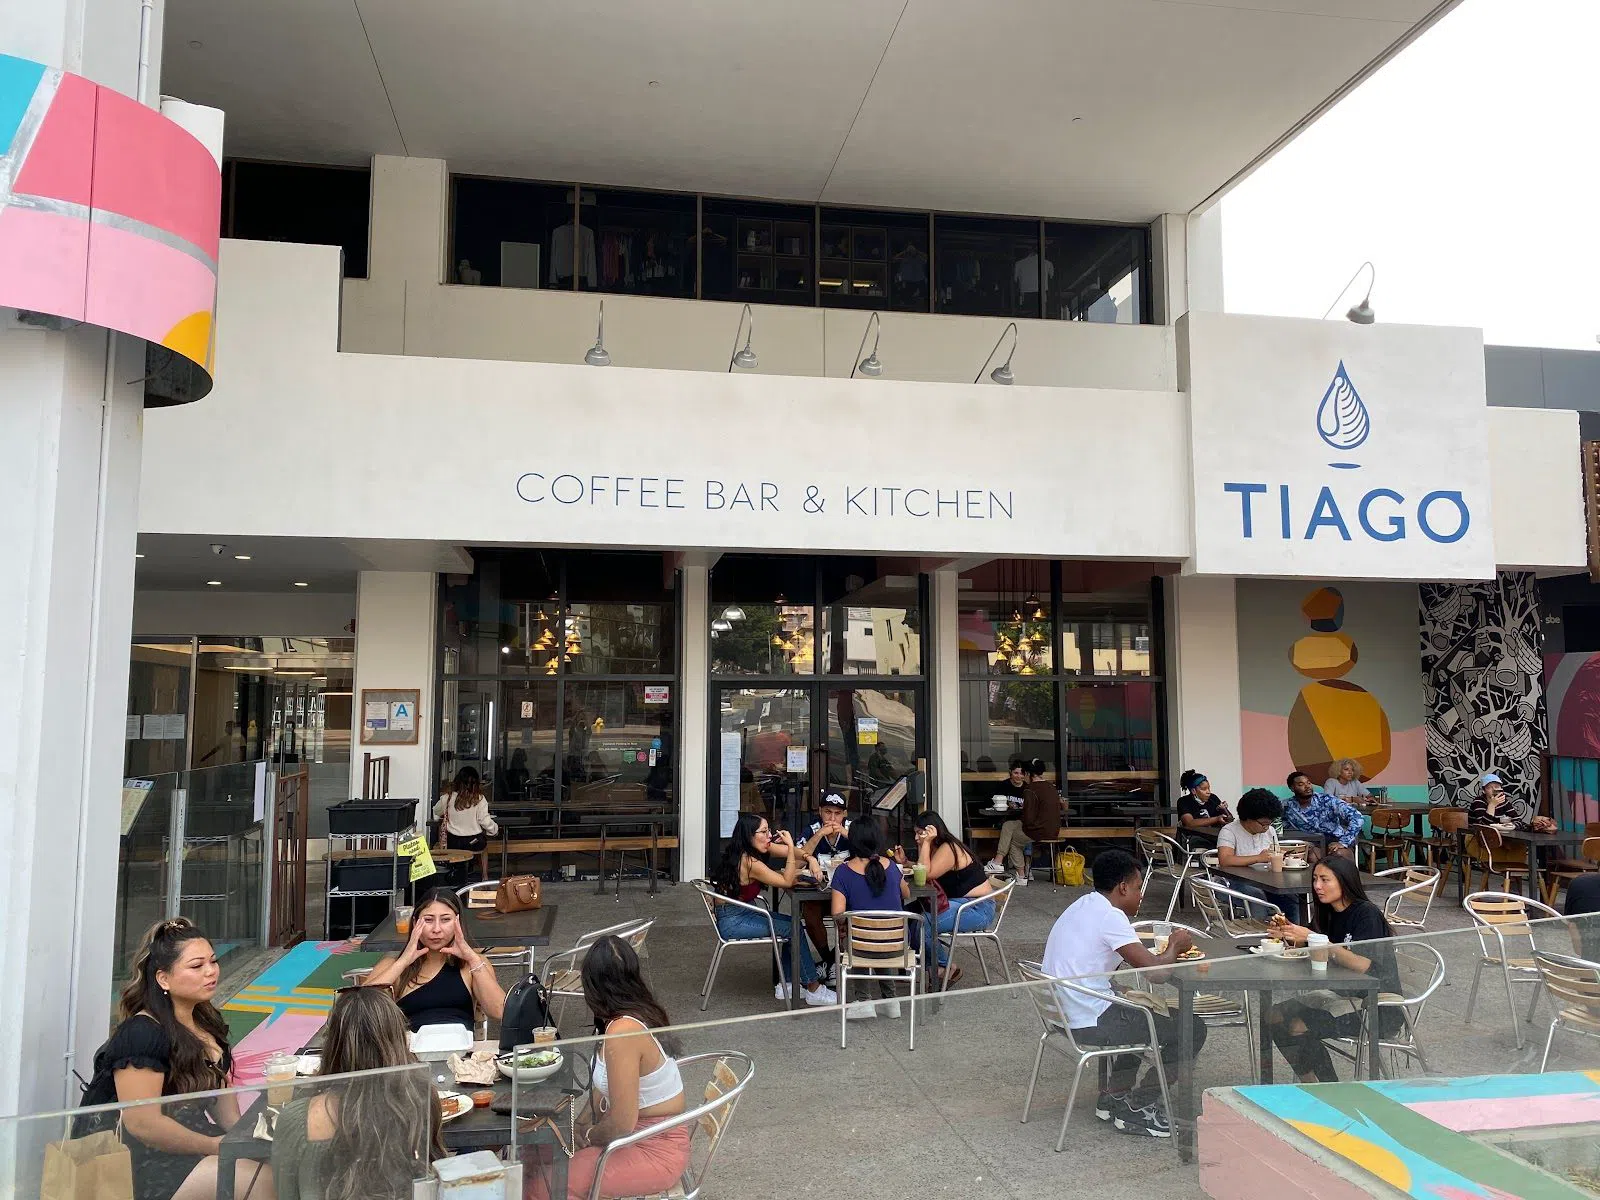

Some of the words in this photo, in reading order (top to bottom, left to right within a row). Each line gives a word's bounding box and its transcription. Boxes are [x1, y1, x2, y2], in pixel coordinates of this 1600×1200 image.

[516, 472, 686, 509] COFFEE
[706, 480, 780, 512] BAR
[802, 484, 826, 514] &
[846, 485, 1013, 520] KITCHEN
[1223, 483, 1471, 544] TIAGO
[395, 703, 409, 717] A
